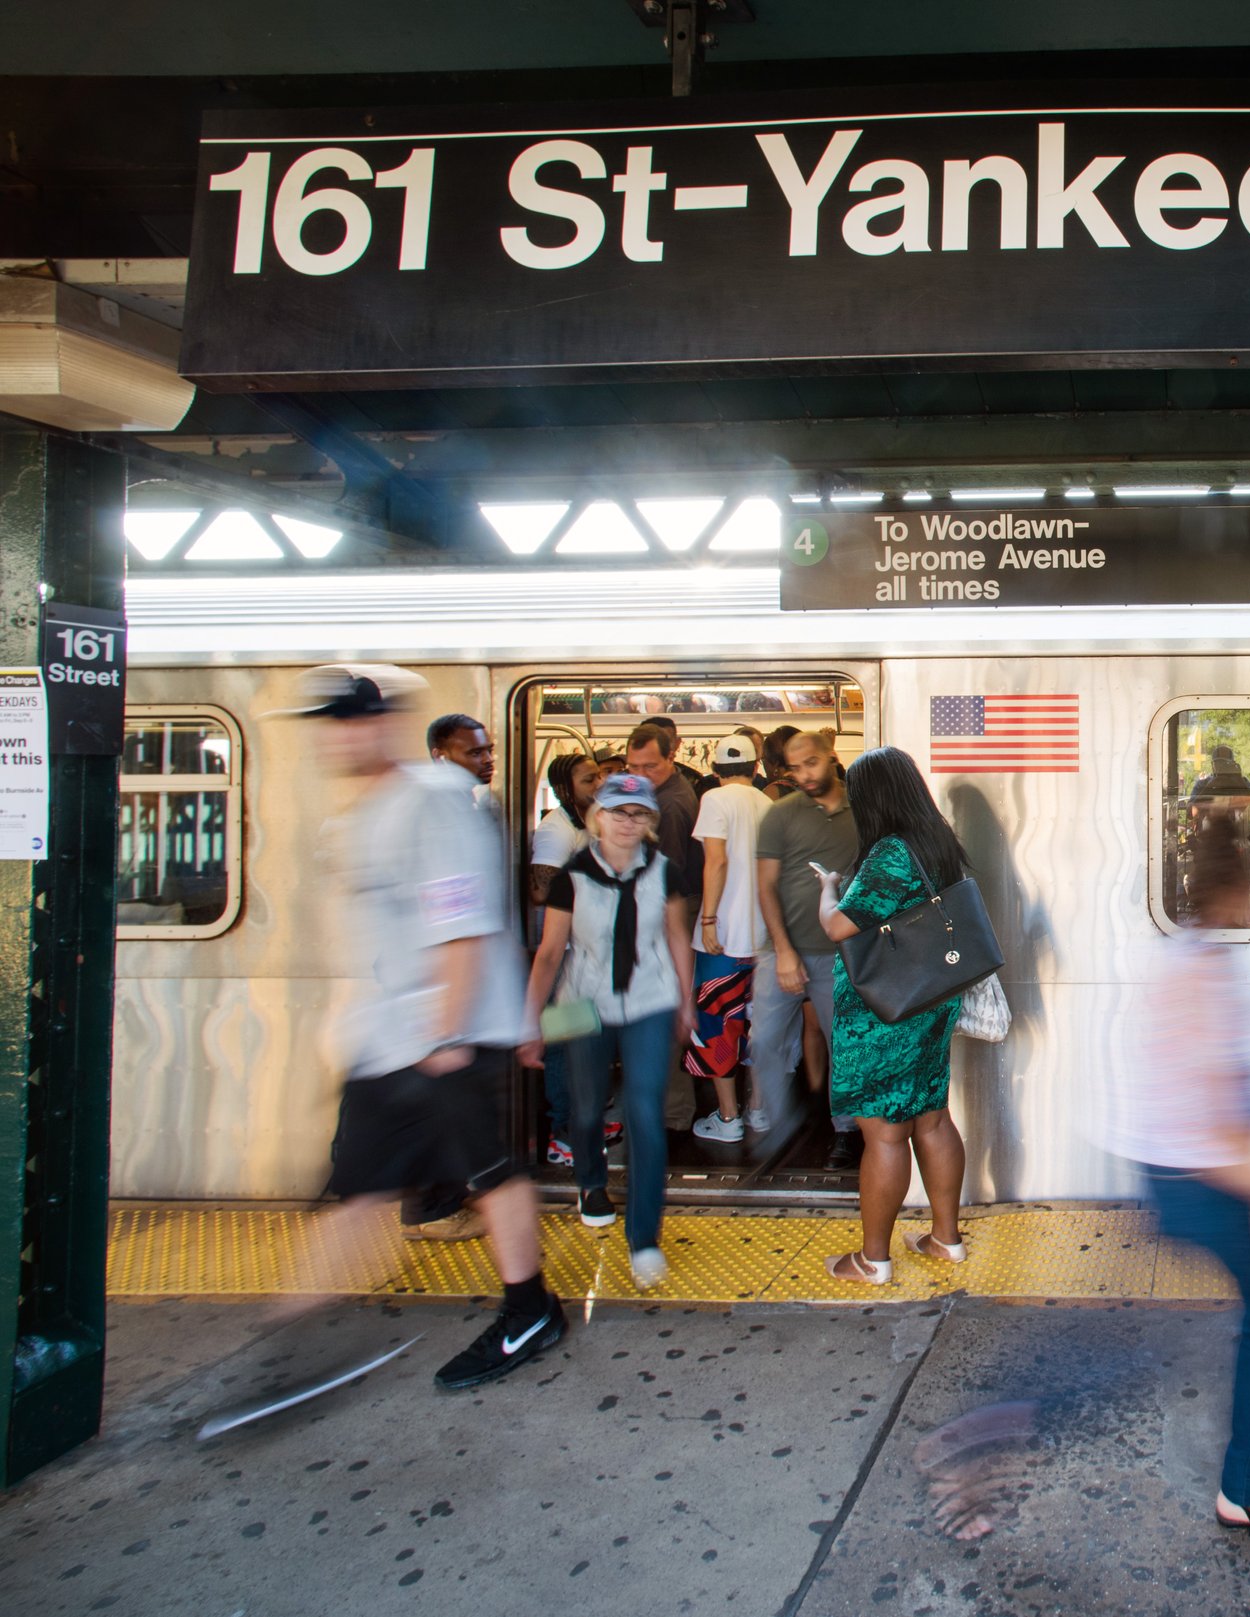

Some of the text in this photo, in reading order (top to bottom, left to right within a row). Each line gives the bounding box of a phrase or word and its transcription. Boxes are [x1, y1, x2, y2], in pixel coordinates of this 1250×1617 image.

[209, 147, 436, 276] 161
[794, 528, 815, 556] 4
[875, 514, 1090, 542] To Woodlawn-
[874, 544, 1106, 573] Jerome Avenue
[875, 575, 1000, 602] all times
[57, 628, 115, 662] 161
[49, 663, 120, 687] Street
[12, 752, 43, 766] this
